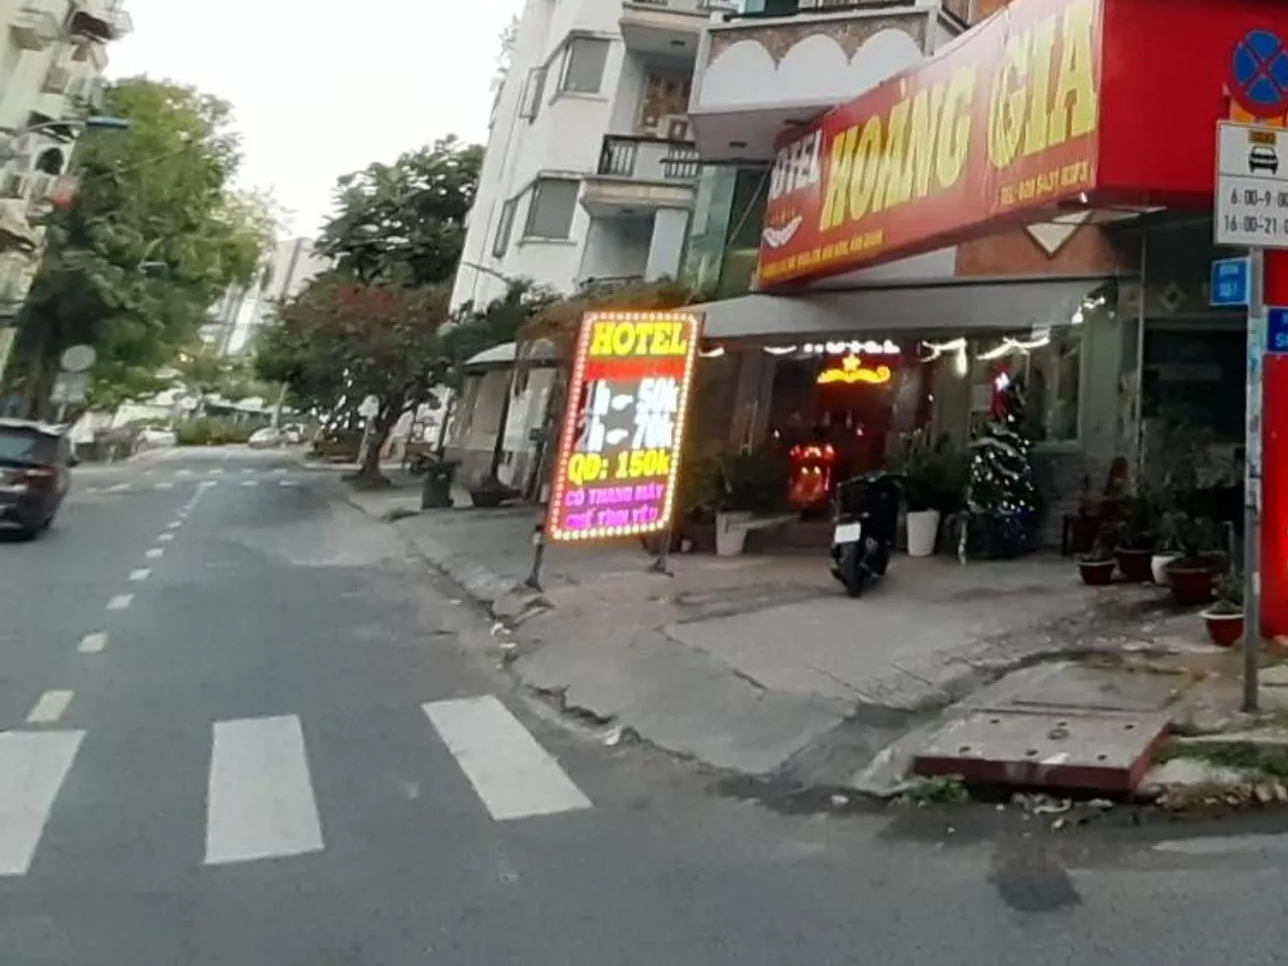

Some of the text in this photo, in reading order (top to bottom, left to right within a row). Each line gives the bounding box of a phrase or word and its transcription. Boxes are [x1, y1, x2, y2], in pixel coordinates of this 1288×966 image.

[767, 126, 823, 202] OTEL
[589, 321, 687, 356] HOTEL
[615, 448, 670, 479] 150k
